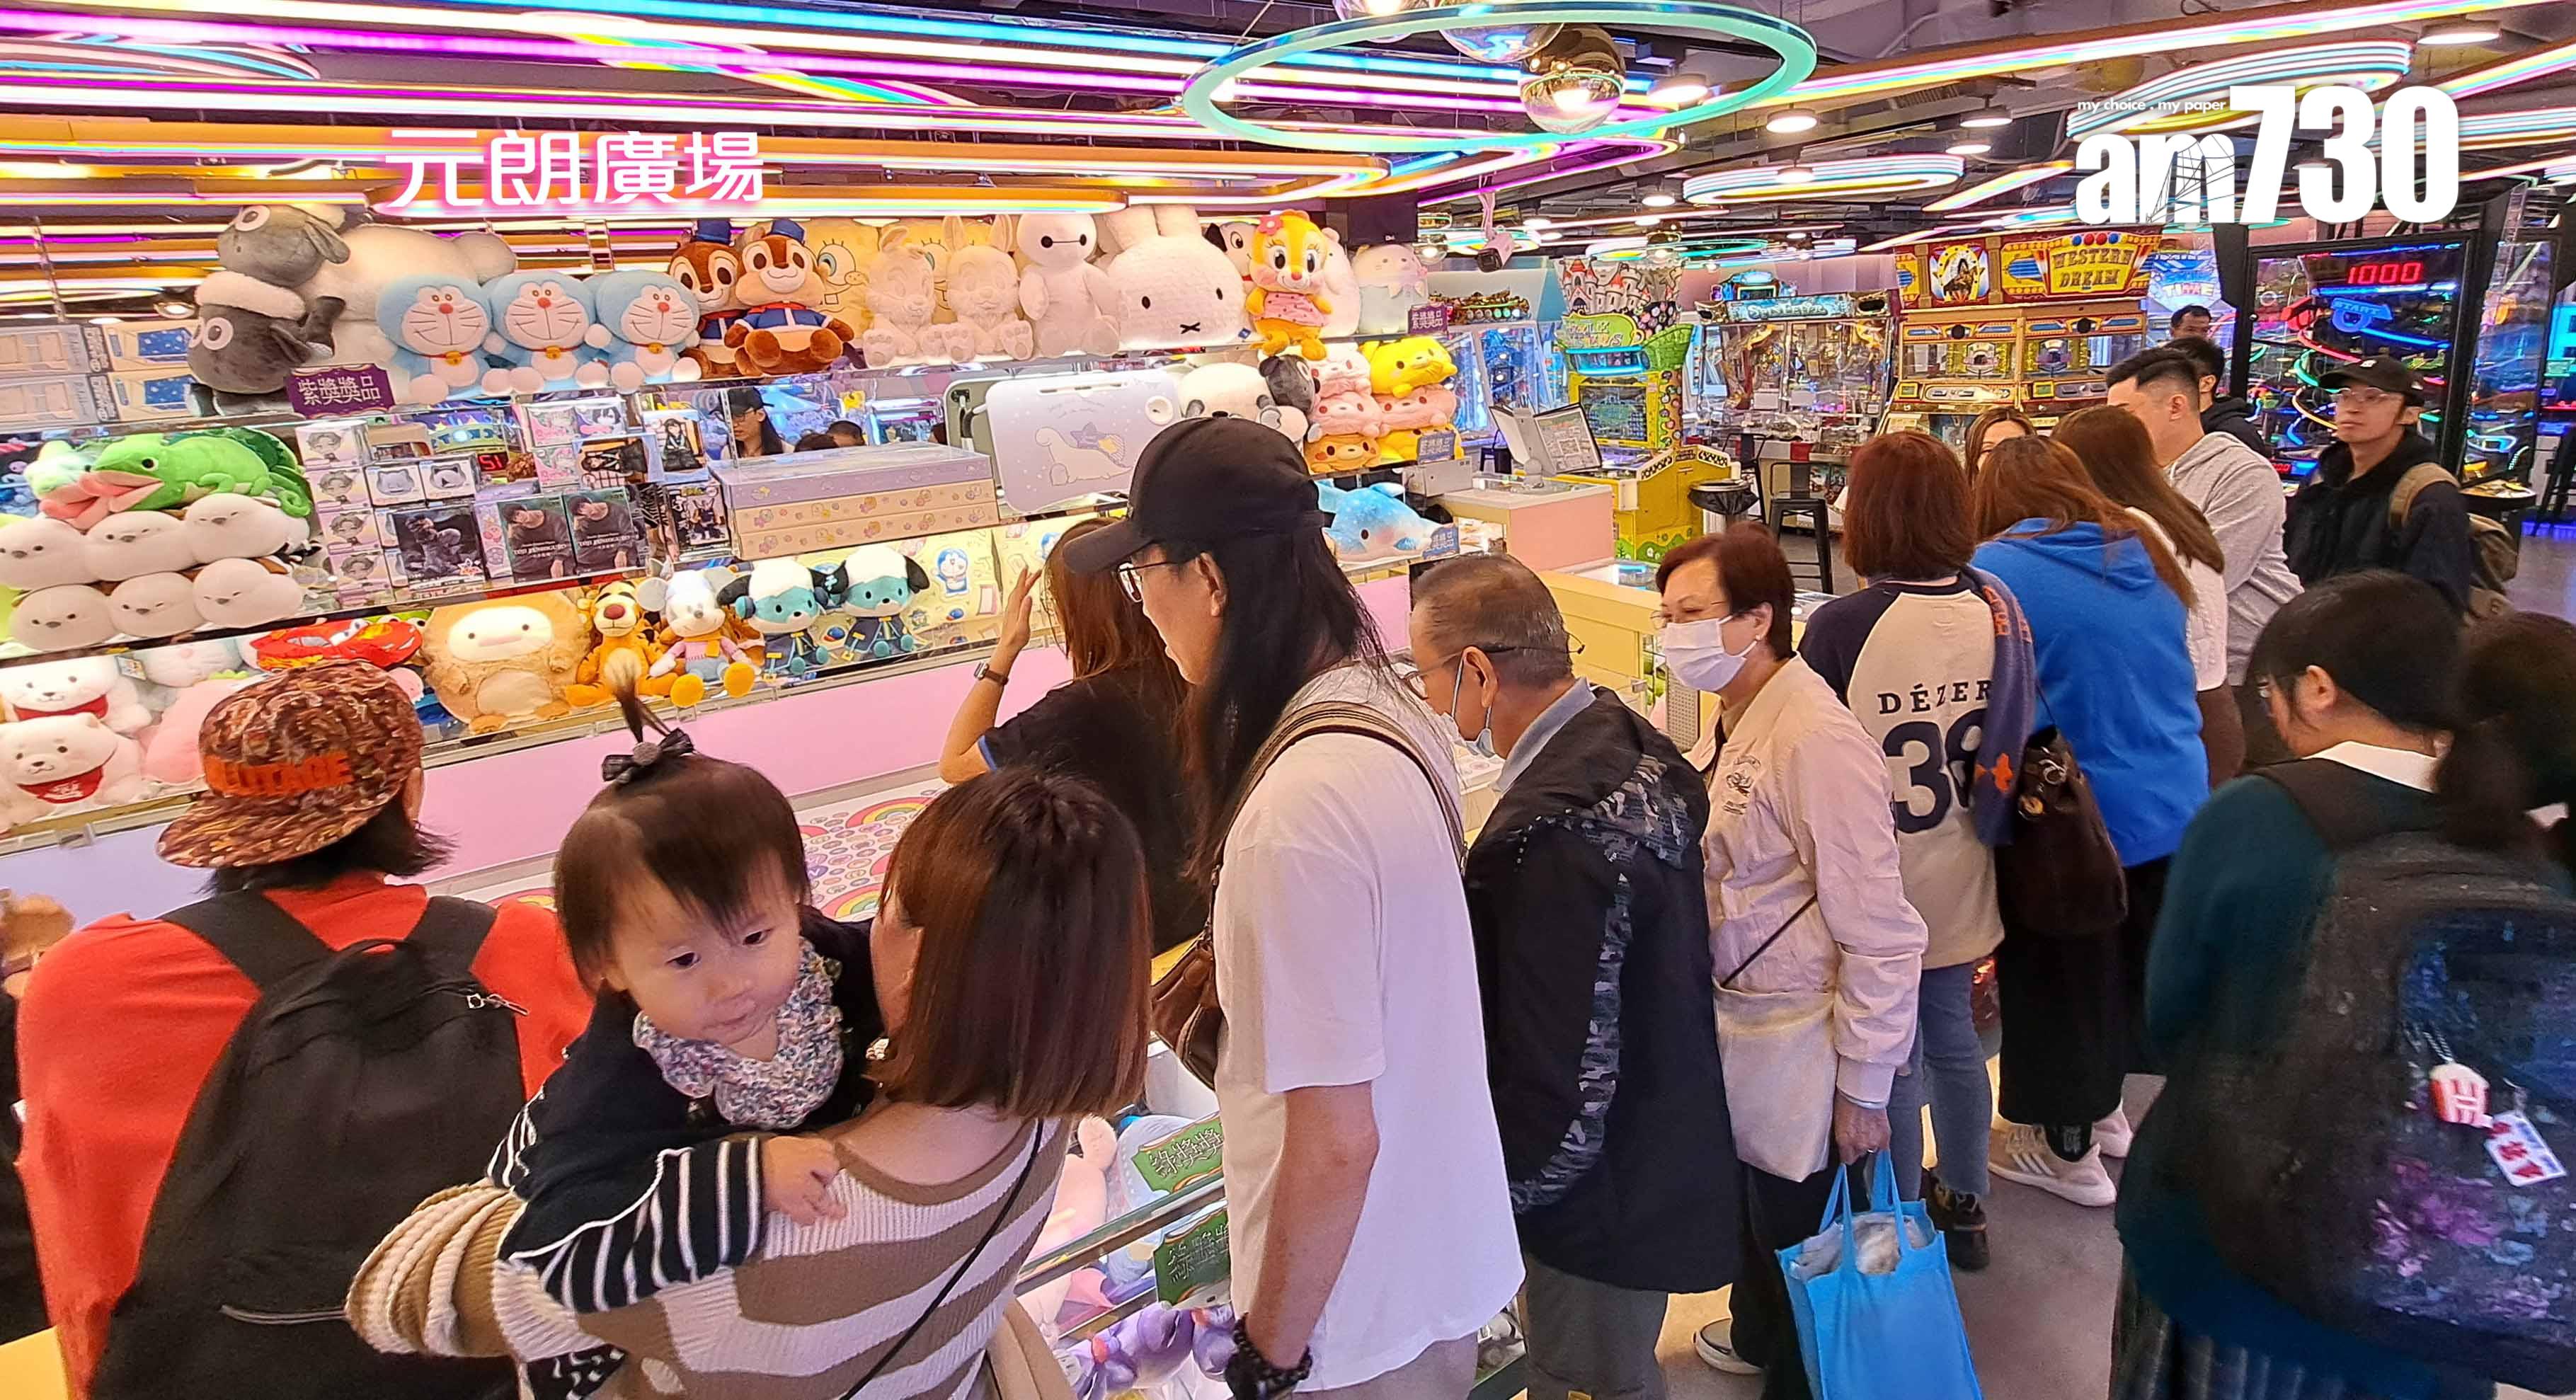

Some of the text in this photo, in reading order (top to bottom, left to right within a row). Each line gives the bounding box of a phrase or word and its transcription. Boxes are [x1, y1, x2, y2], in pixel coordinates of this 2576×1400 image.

[2053, 248, 2134, 269] WESTERN
[2059, 269, 2121, 288] DREAM
[2347, 262, 2424, 285] 1000
[2162, 282, 2214, 297] TIME
[2333, 300, 2381, 315] START
[297, 375, 382, 406] 紫獎獎品
